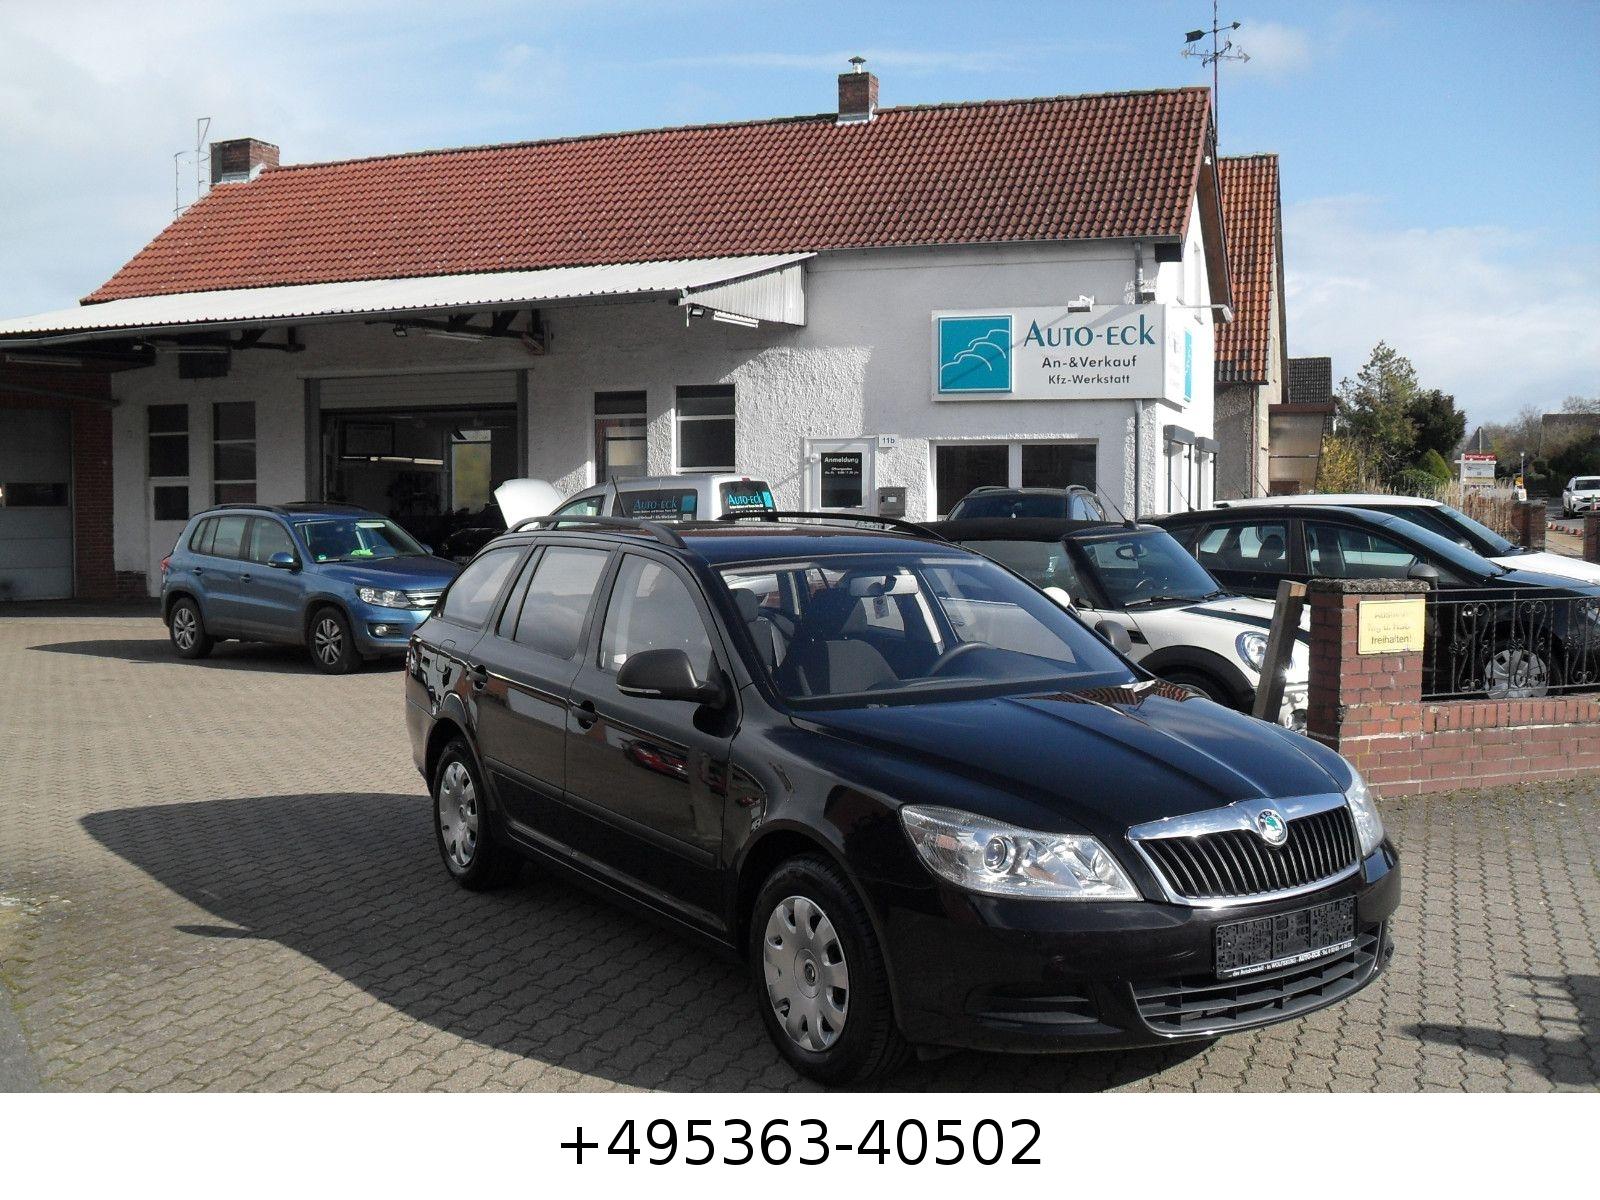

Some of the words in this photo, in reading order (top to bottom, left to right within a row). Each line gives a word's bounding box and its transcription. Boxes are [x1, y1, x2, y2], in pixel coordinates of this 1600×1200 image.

[1041, 354, 1137, 369] An-&Verkauf
[1048, 374, 1130, 385] Kfz-Werkstatt
[824, 456, 859, 464] Anmeldung
